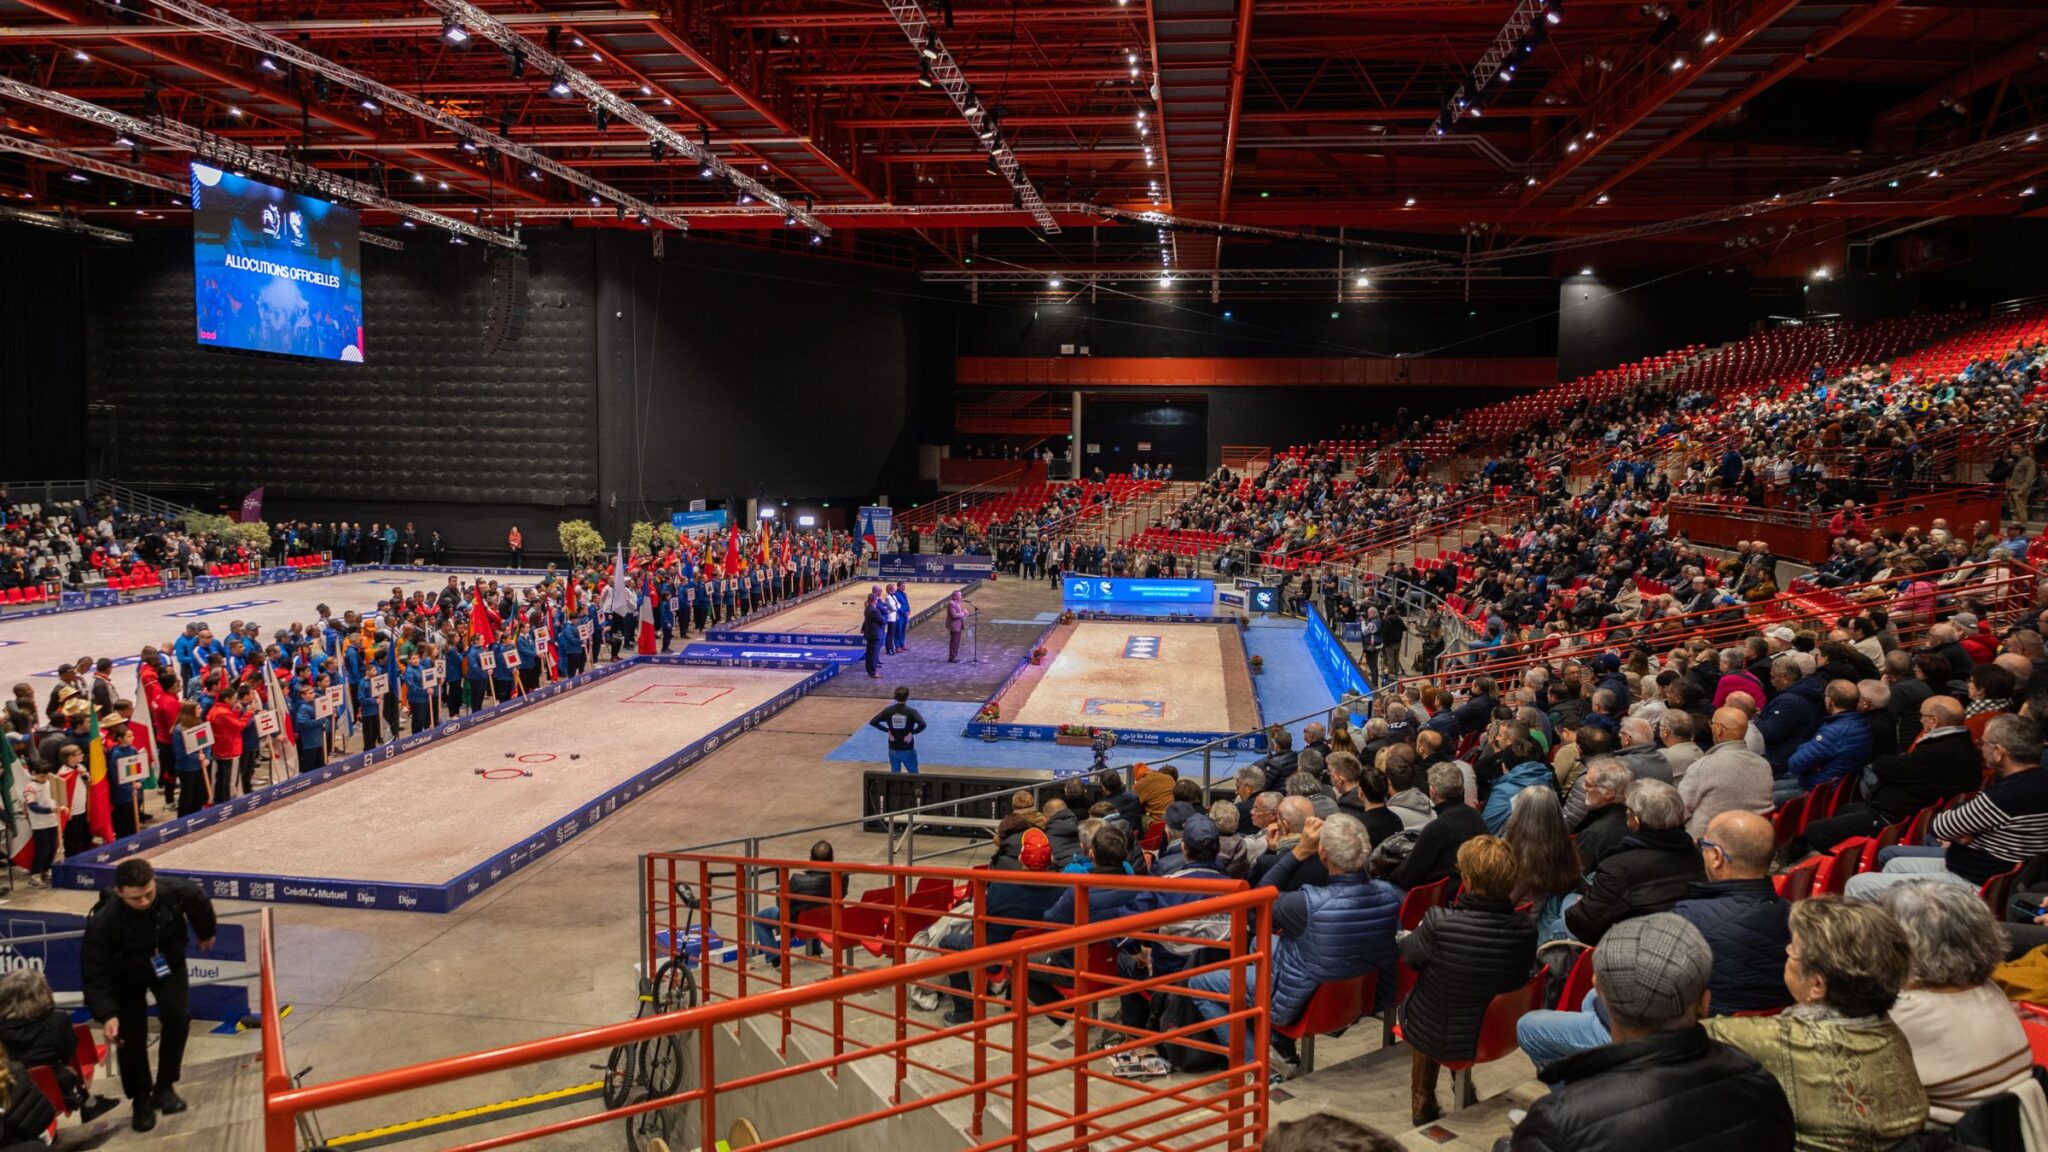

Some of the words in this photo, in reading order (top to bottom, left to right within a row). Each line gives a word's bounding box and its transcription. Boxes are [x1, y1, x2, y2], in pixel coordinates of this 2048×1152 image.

[225, 254, 289, 279] ALLOCUTIONS
[289, 266, 340, 289] OFFICIELLES
[926, 562, 944, 573] Dijon
[283, 886, 308, 896] Crédit
[318, 888, 347, 900] Mutuel
[357, 892, 376, 904] Dijon
[398, 895, 417, 907] Dijon
[187, 966, 219, 978] utuel
